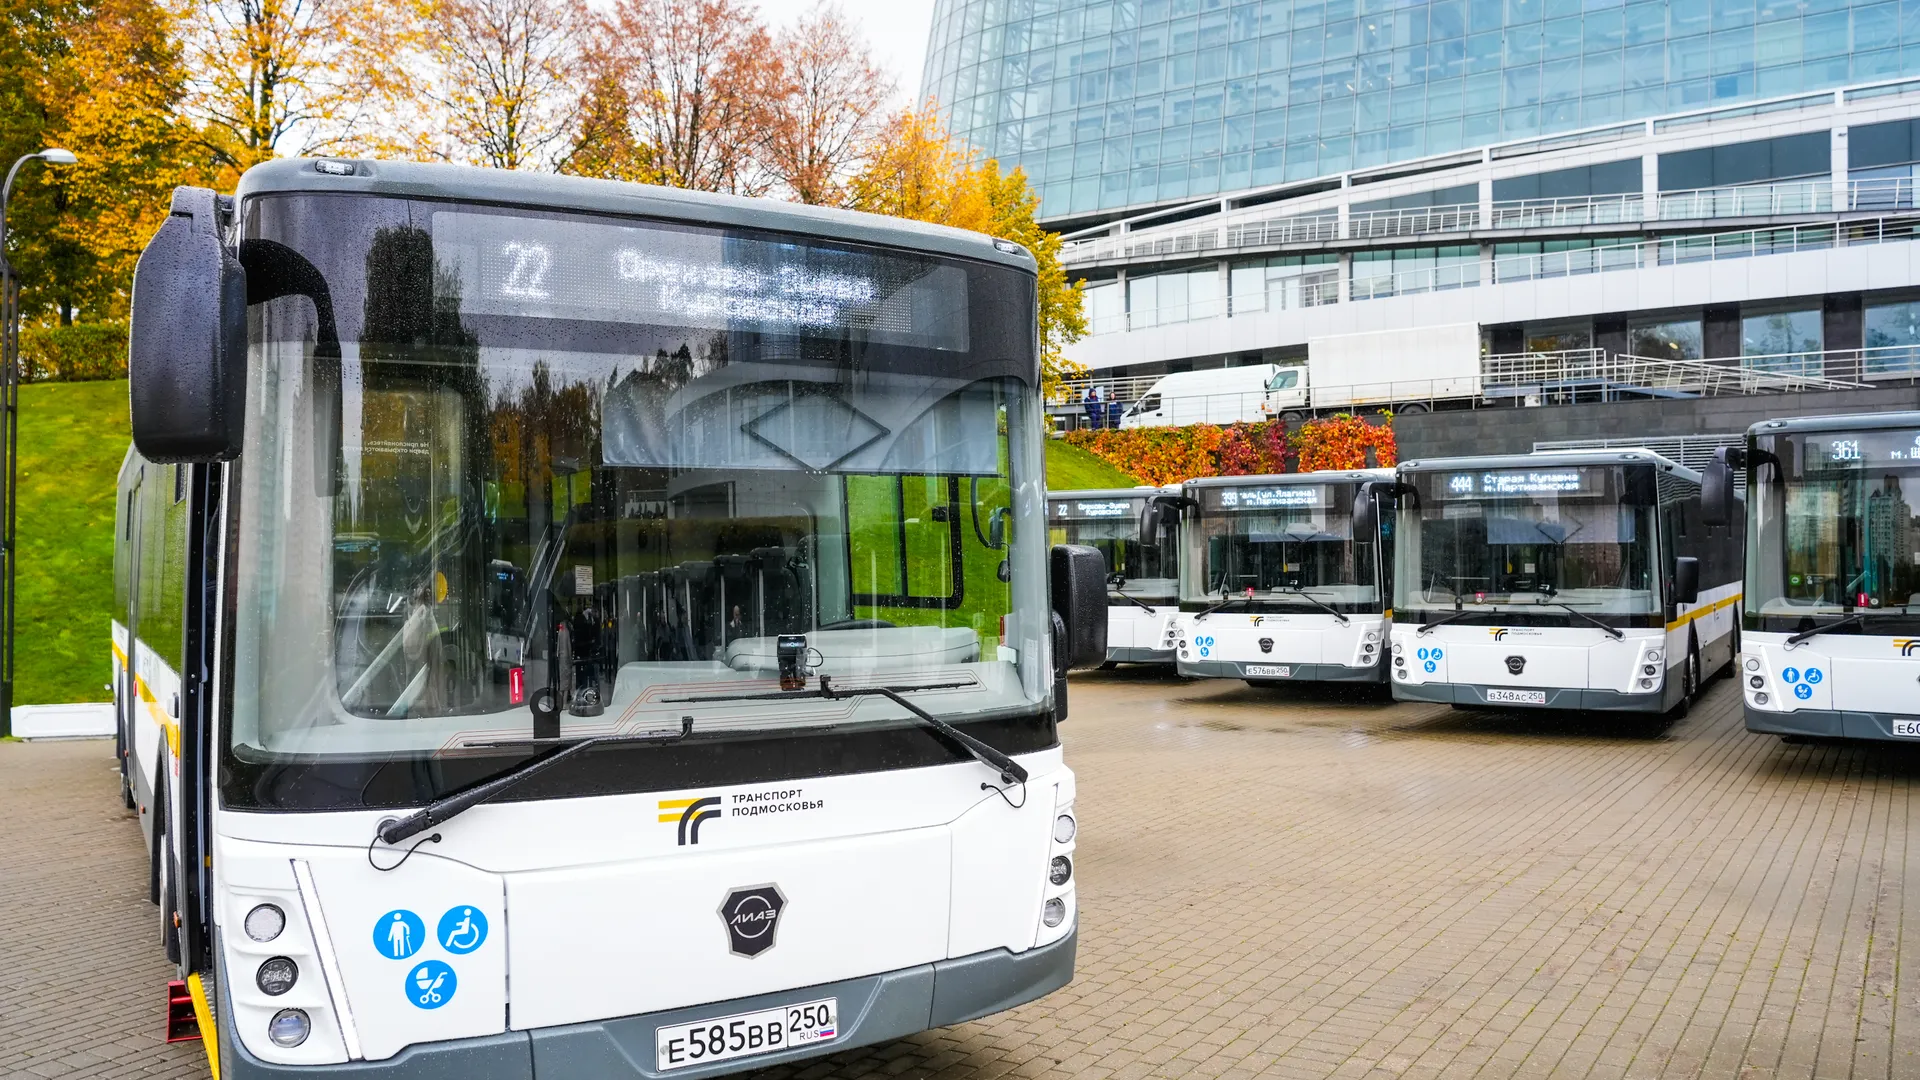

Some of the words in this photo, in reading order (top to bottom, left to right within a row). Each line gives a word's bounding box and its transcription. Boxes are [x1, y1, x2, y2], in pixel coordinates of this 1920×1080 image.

[501, 240, 553, 300] 22
[1832, 440, 1861, 460] 361
[1451, 476, 1473, 492] 444
[1484, 474, 1525, 484] Старая
[1530, 473, 1579, 484] Купавна
[1058, 504, 1068, 516] 22
[1528, 692, 1543, 700] 250
[732, 789, 804, 804] ТРАНСПОРТ
[732, 800, 824, 817] ПОДМОСКОВЬЯ
[730, 909, 777, 925] ЛИАЗ
[668, 1020, 783, 1064] Е585ВВ
[789, 1004, 829, 1033] 250
[799, 1030, 819, 1041] RUS
